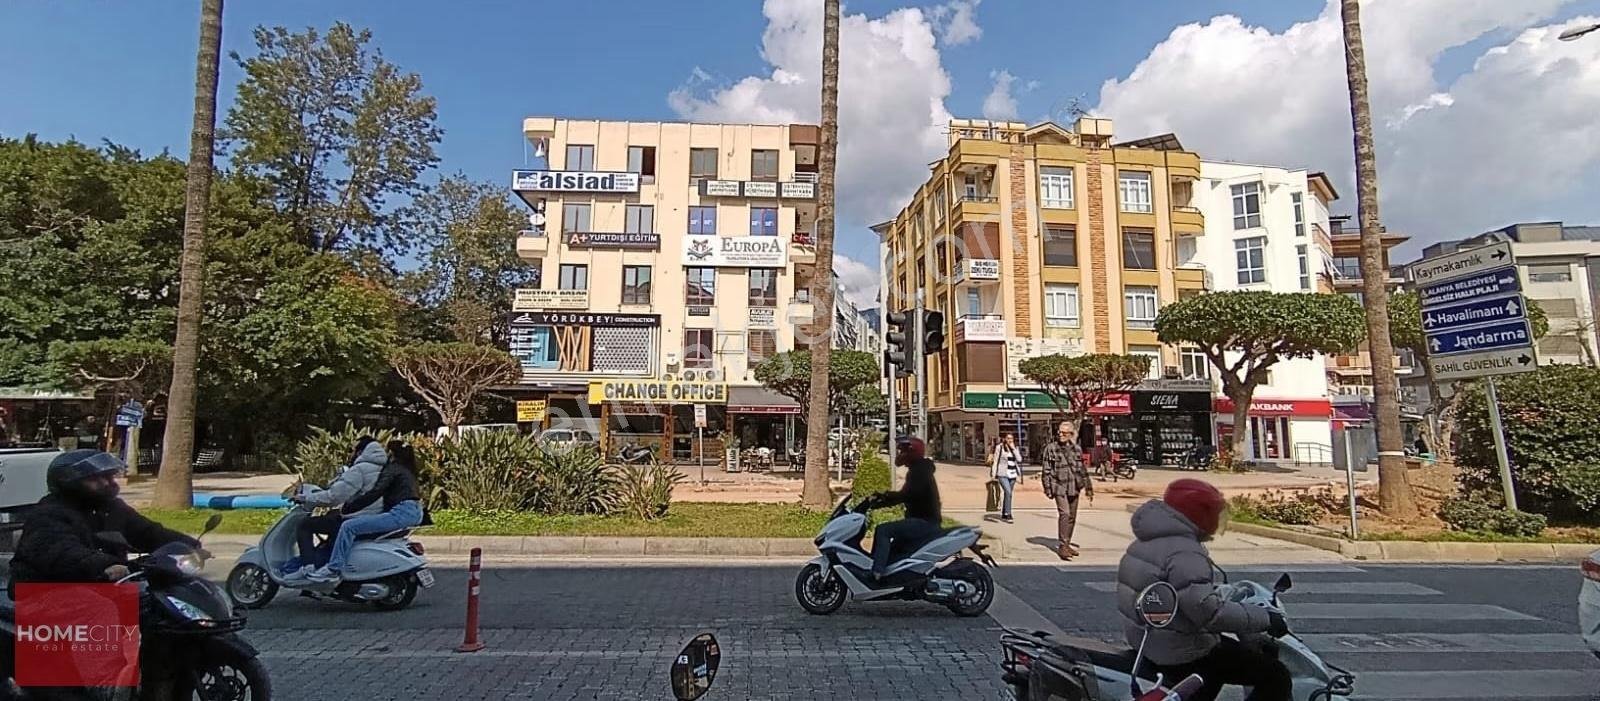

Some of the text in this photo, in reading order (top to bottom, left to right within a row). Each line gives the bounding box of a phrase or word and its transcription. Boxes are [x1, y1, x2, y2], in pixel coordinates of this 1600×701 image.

[540, 173, 614, 189] alsiad
[570, 233, 588, 244] A+
[1428, 275, 1497, 295] ALANYA BELEDİYESİ
[1455, 289, 1475, 299] HALK
[1476, 284, 1499, 294] PLAJI
[543, 314, 610, 323] YÖRÜKBEY
[1437, 306, 1503, 324] Havalimanı
[1454, 329, 1526, 347] Jandarma
[1435, 355, 1512, 373] SAHİL GÜVENLİK
[604, 383, 724, 400] CHANGE OFFICE
[998, 394, 1025, 408] inci
[1150, 395, 1179, 405] SIENA
[1250, 403, 1293, 411] AKBANK
